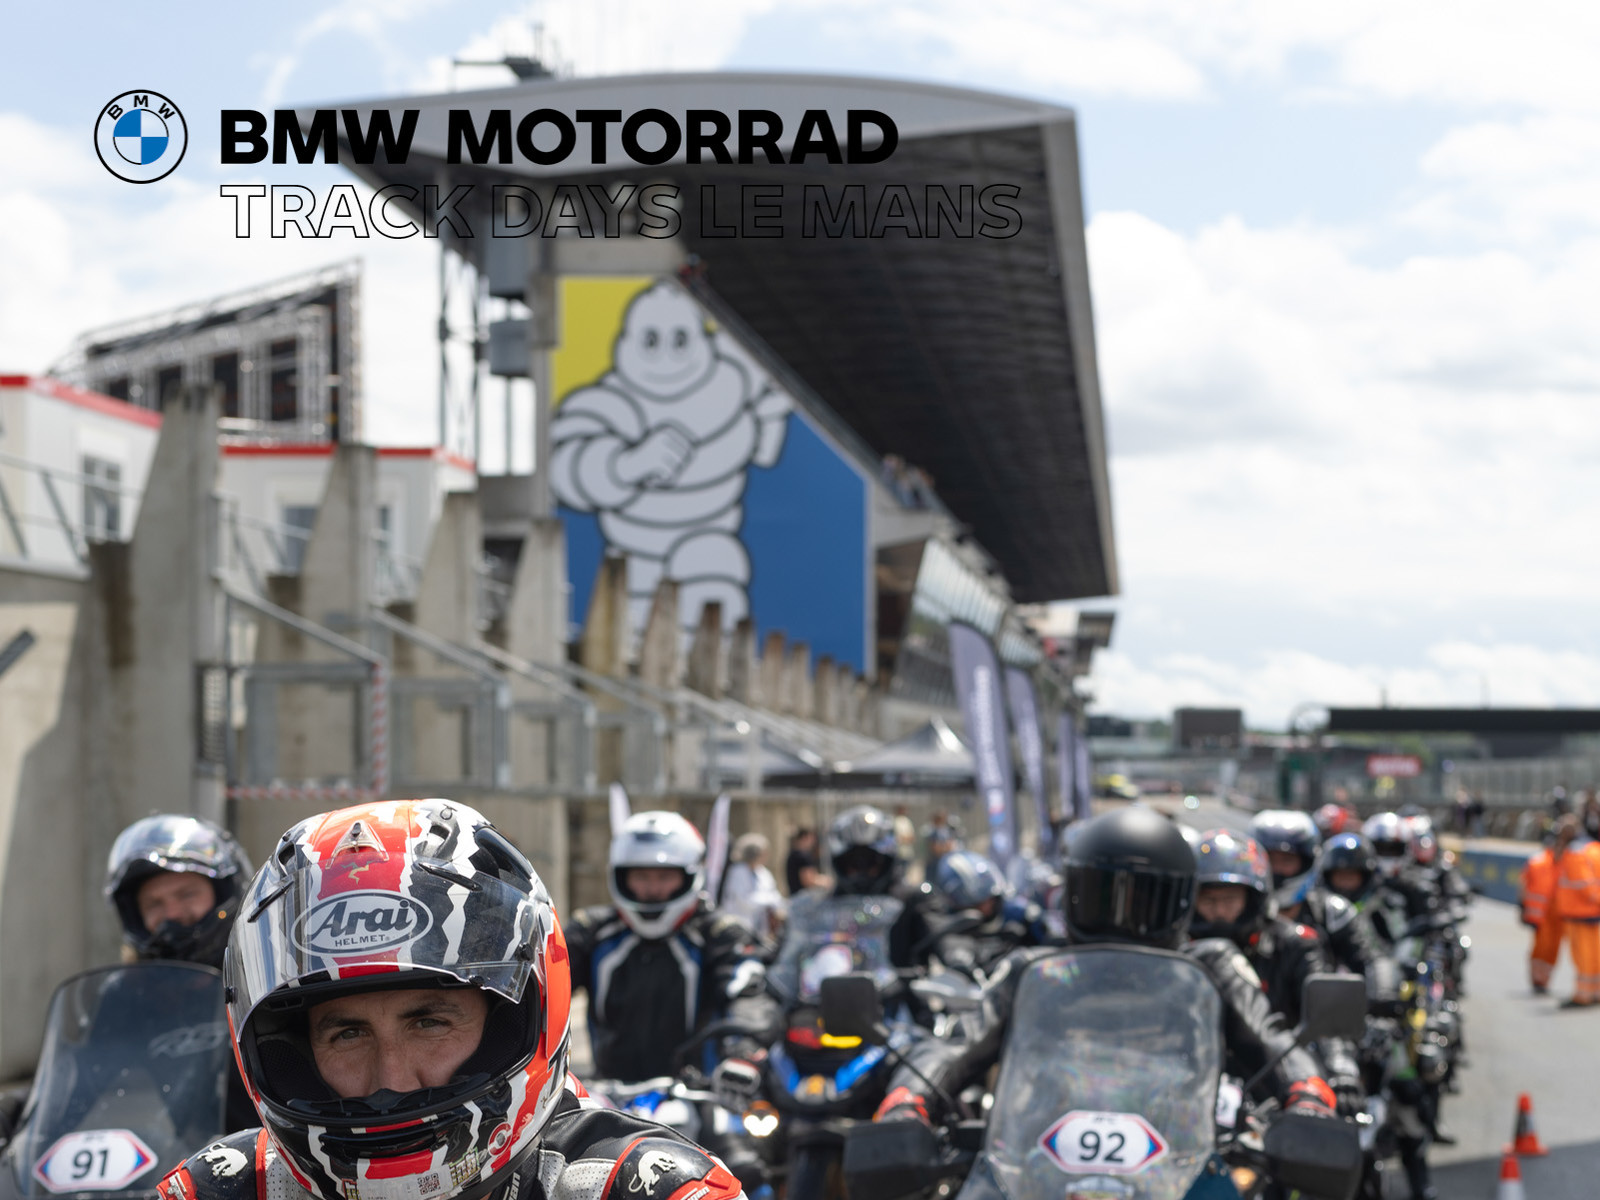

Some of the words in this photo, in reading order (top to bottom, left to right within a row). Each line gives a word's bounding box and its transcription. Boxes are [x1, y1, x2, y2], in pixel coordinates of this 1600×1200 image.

[304, 899, 413, 942] Arai
[335, 934, 386, 947] HELMET
[1080, 1130, 1125, 1163] 92
[71, 1148, 108, 1180] 91
